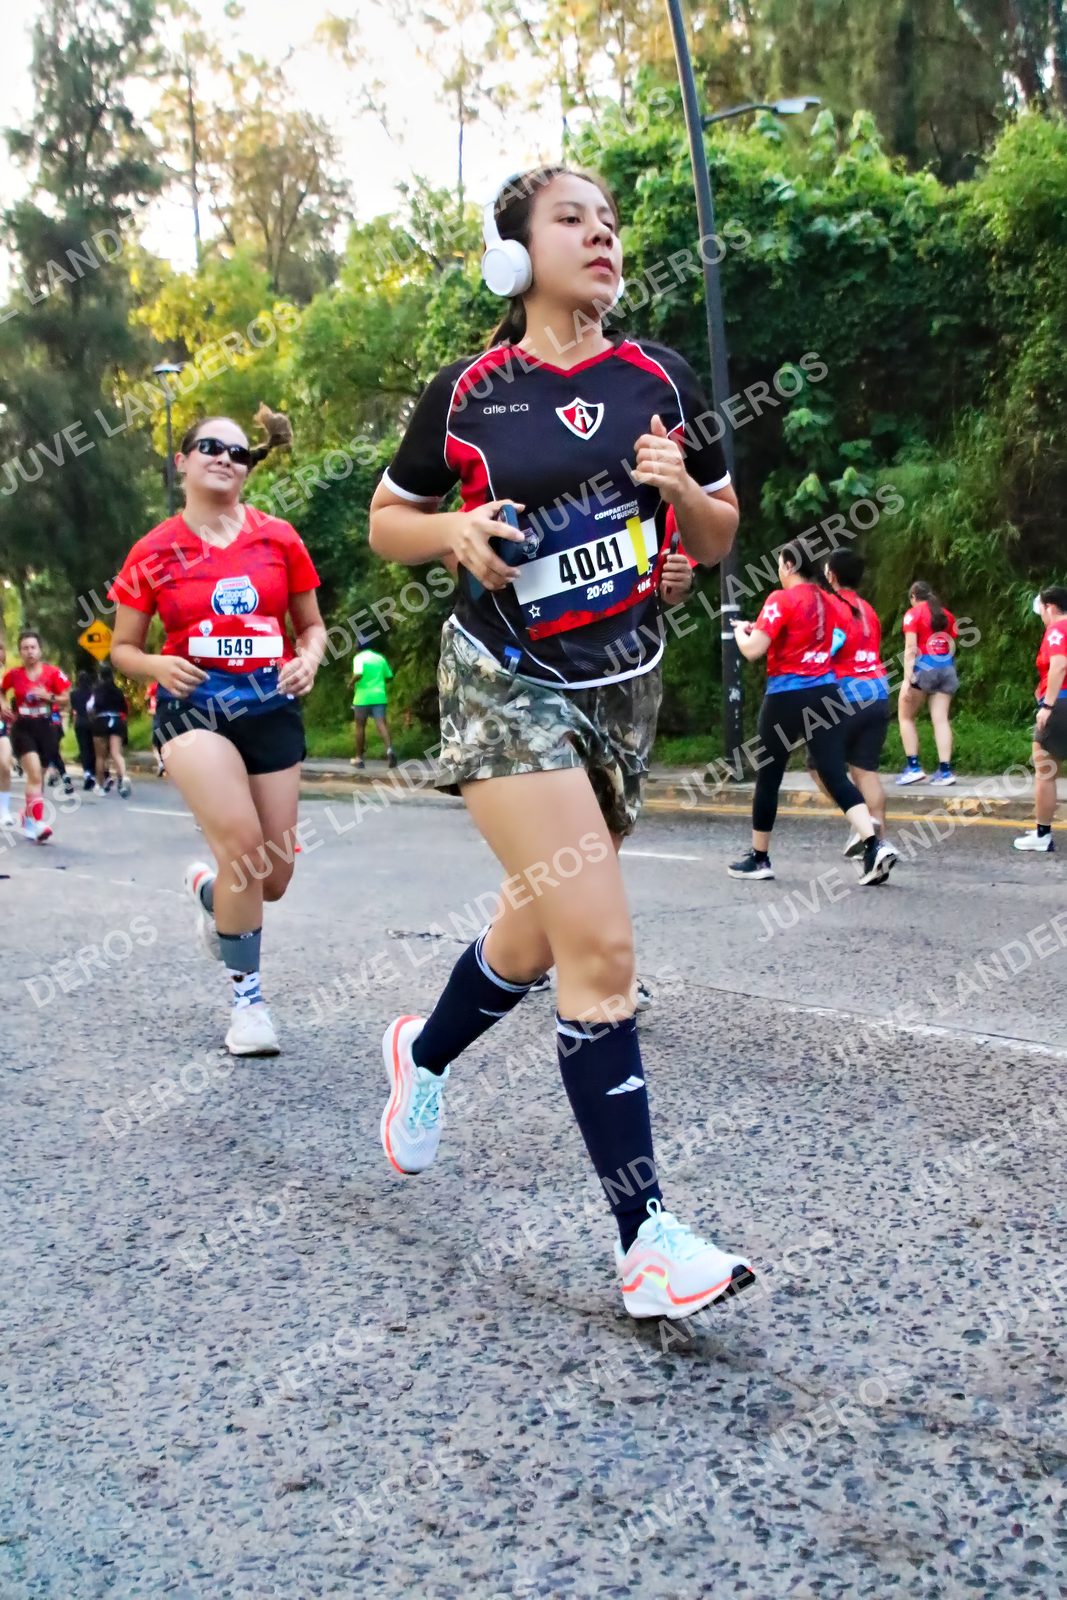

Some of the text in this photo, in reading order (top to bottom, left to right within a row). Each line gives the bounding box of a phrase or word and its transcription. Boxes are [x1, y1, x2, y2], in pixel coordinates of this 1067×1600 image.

[558, 537, 623, 585] 4041
[587, 581, 614, 600] 20-26
[216, 638, 253, 656] 1549
